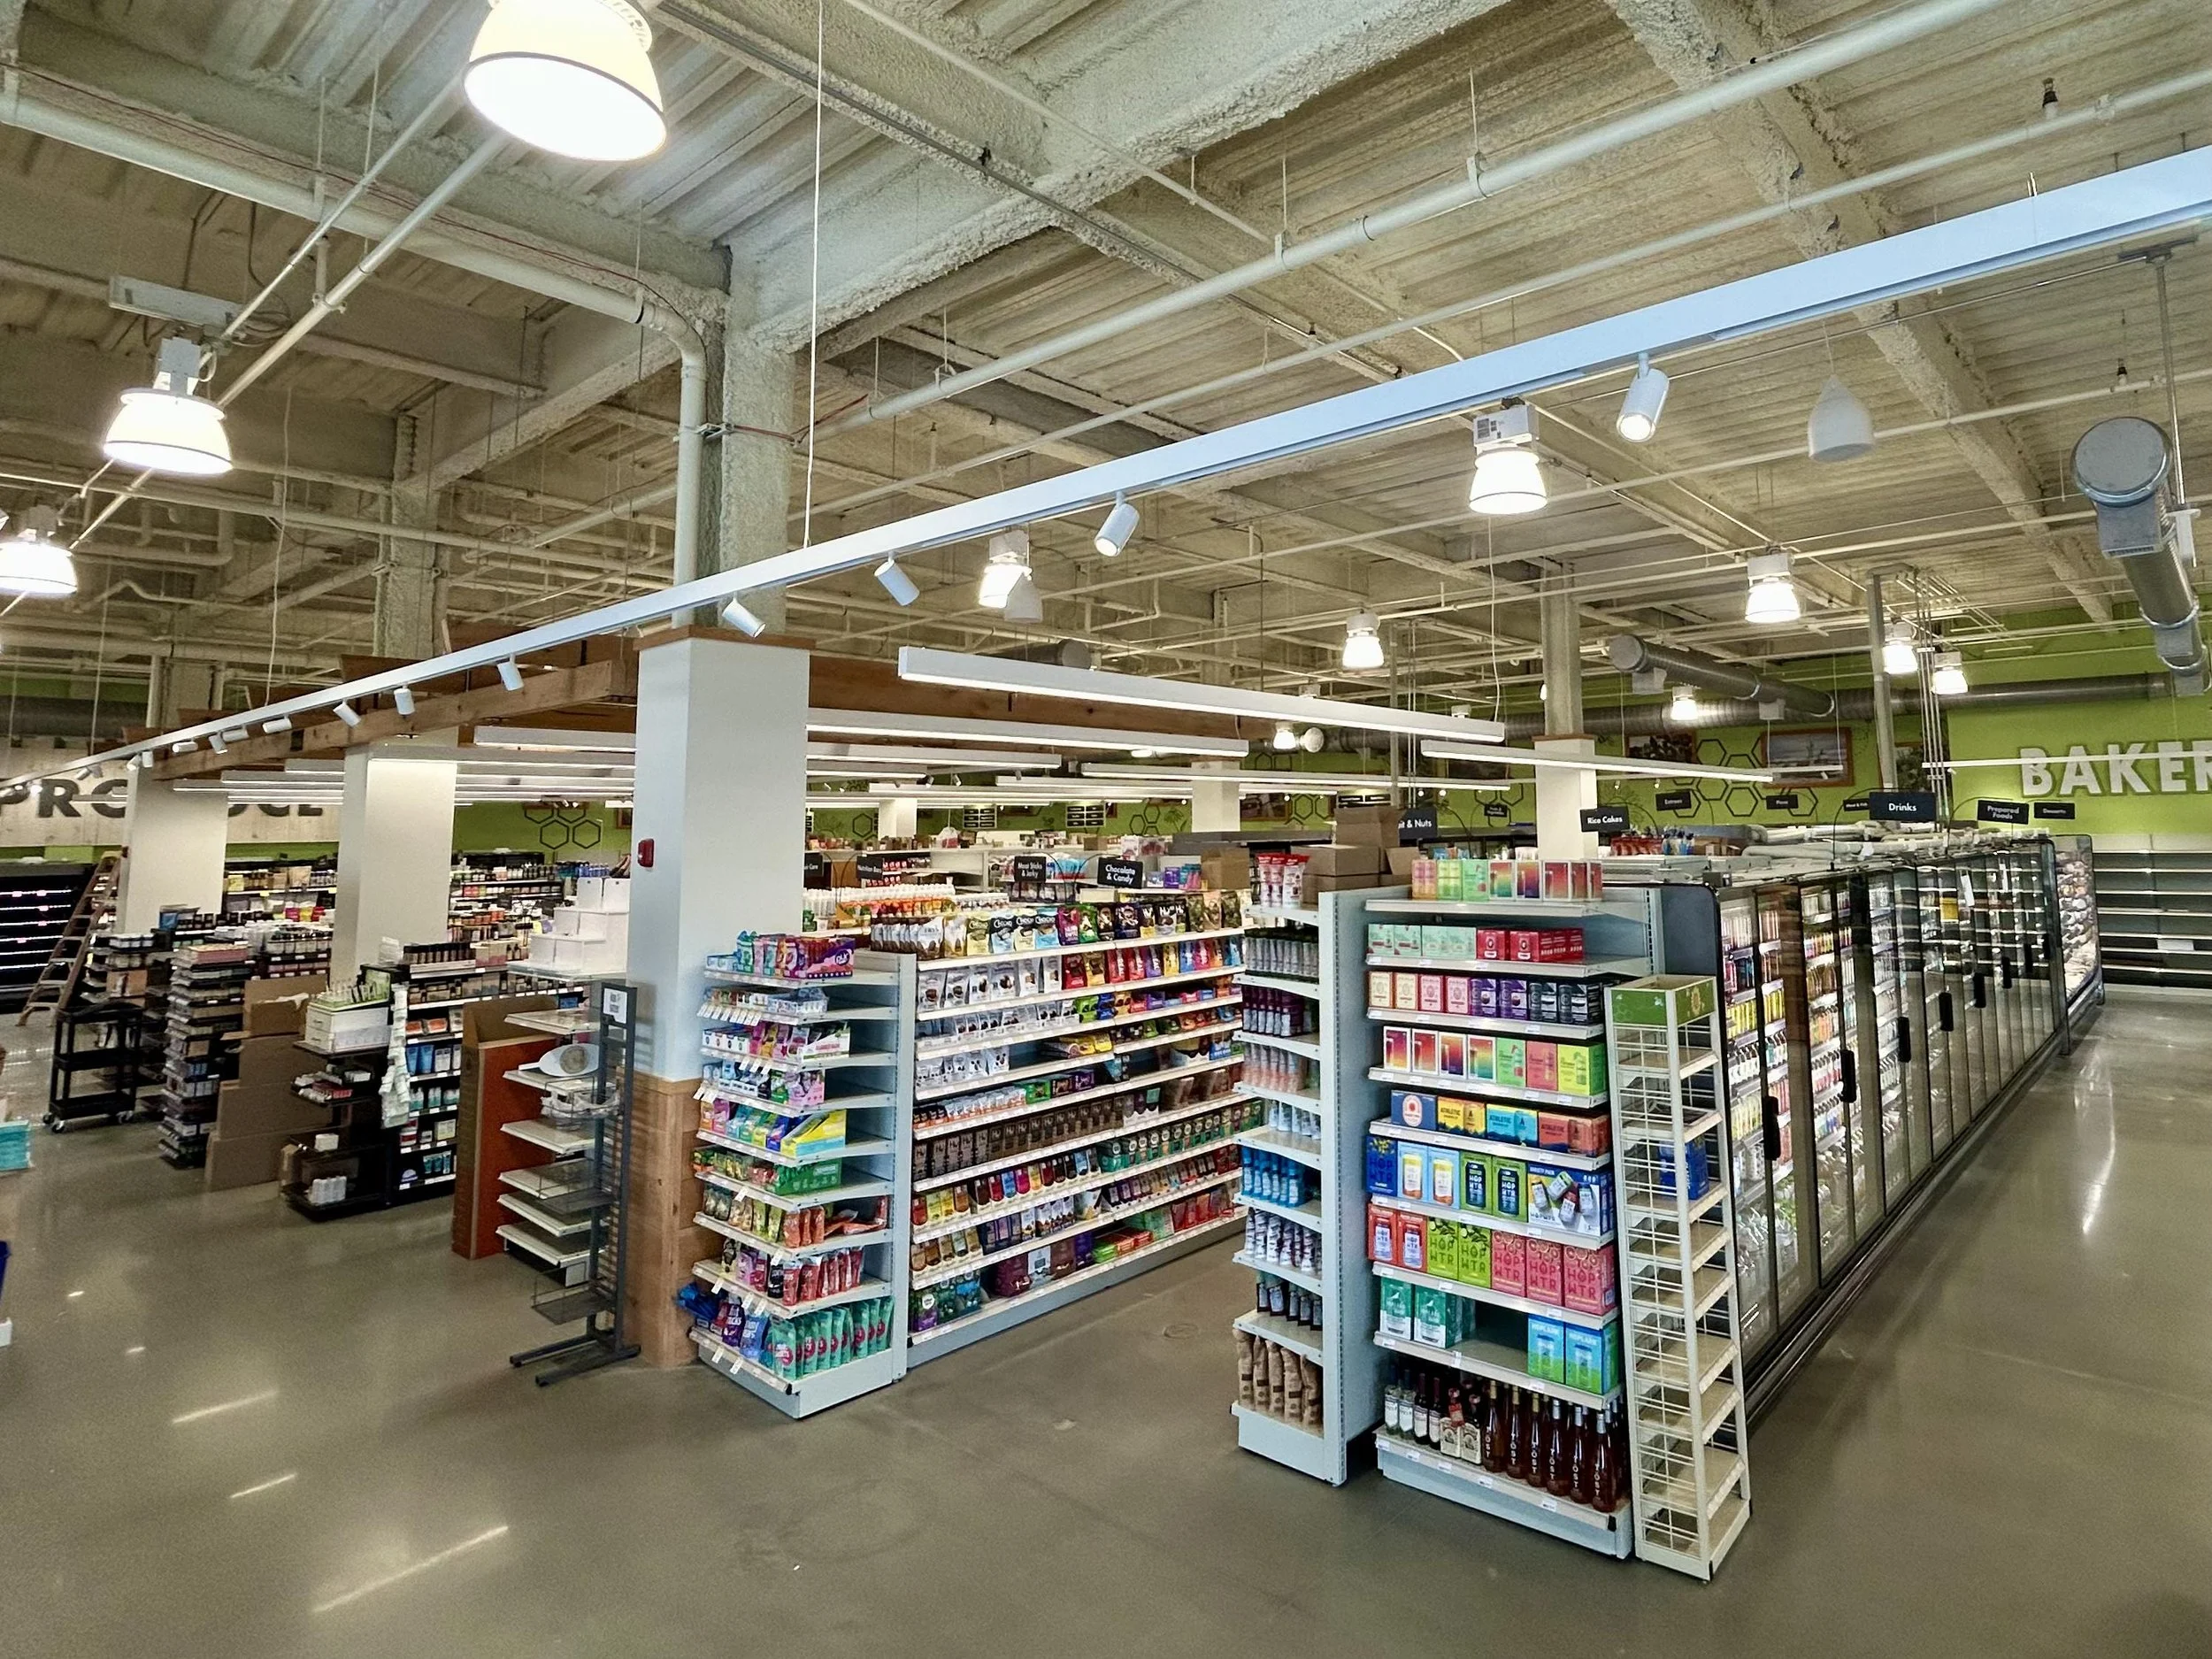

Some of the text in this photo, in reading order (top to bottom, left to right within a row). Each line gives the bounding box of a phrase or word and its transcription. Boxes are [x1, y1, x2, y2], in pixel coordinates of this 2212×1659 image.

[1888, 803, 1917, 811] Drinks
[1987, 805, 2020, 815] Prepared
[1601, 815, 1623, 824] Cakes
[1992, 811, 2014, 820] Foods
[1407, 819, 1413, 828] &
[1414, 818, 1432, 828] Nuts
[1105, 864, 1136, 875] Chocolate
[1113, 871, 1133, 884] Candy
[1430, 1237, 1454, 1251] HOP
[1461, 1244, 1486, 1259] HOP
[1494, 1251, 1520, 1266] HOP
[1529, 1259, 1556, 1275] HOP
[1567, 1267, 1595, 1284] HOP
